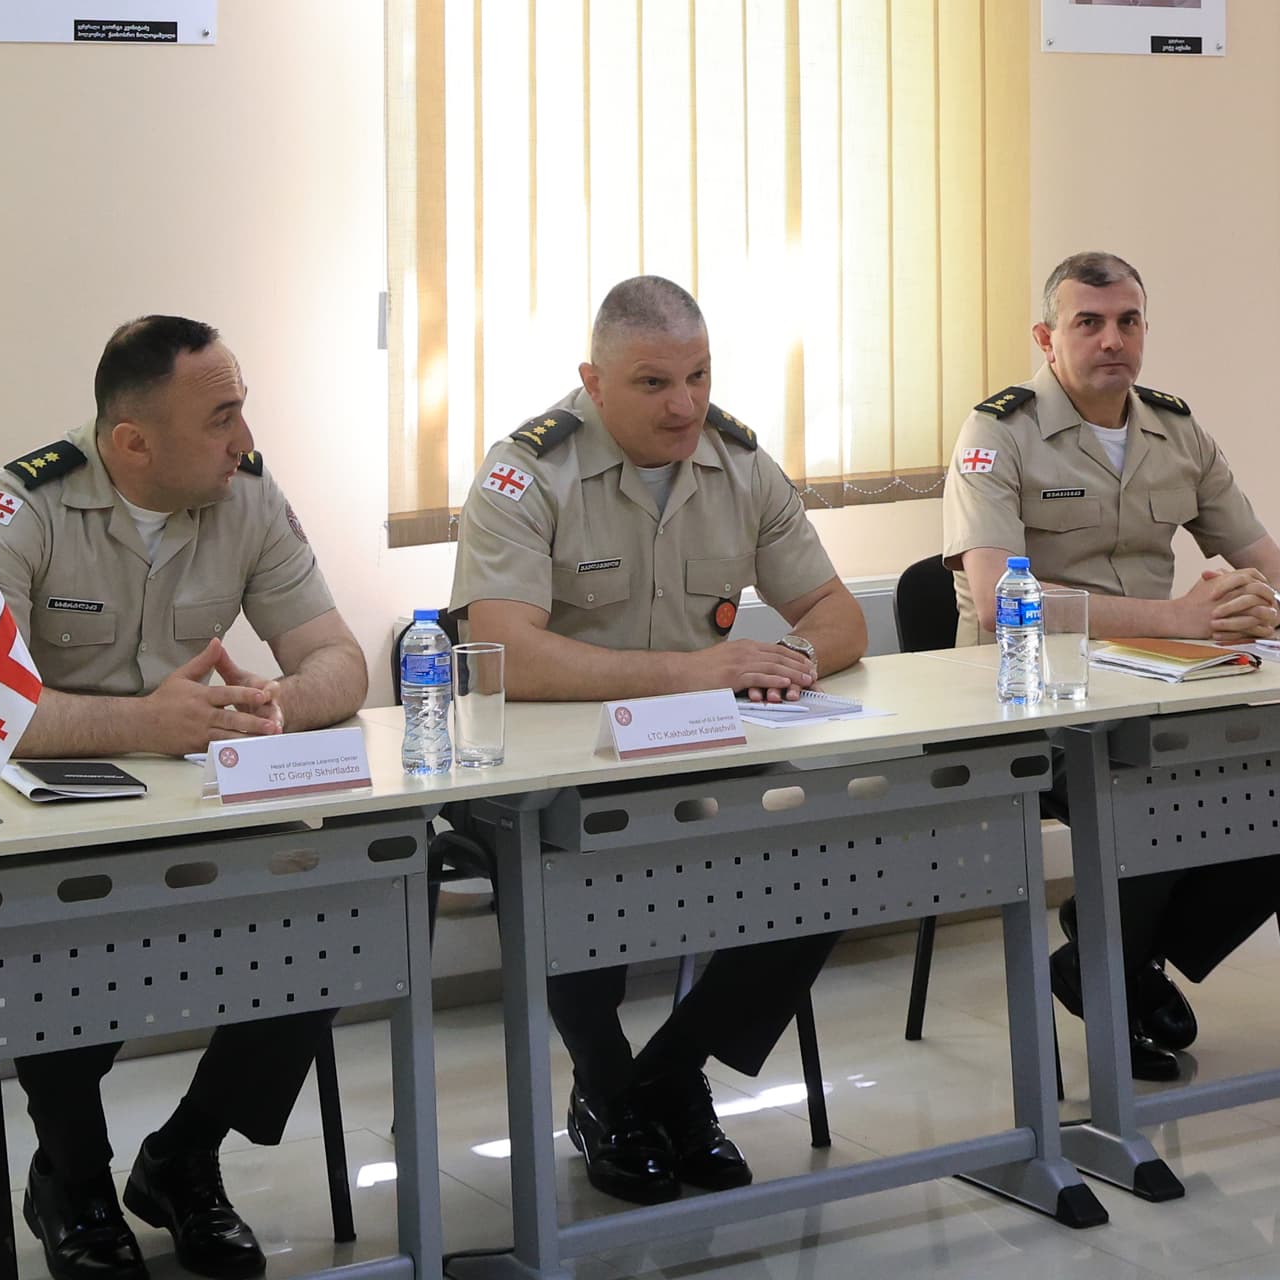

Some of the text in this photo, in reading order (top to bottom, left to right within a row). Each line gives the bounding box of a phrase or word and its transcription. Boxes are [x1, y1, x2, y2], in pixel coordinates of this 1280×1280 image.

[648, 732, 663, 741] LTC
[268, 765, 360, 782] LTC Giorgi Skhirtladze
